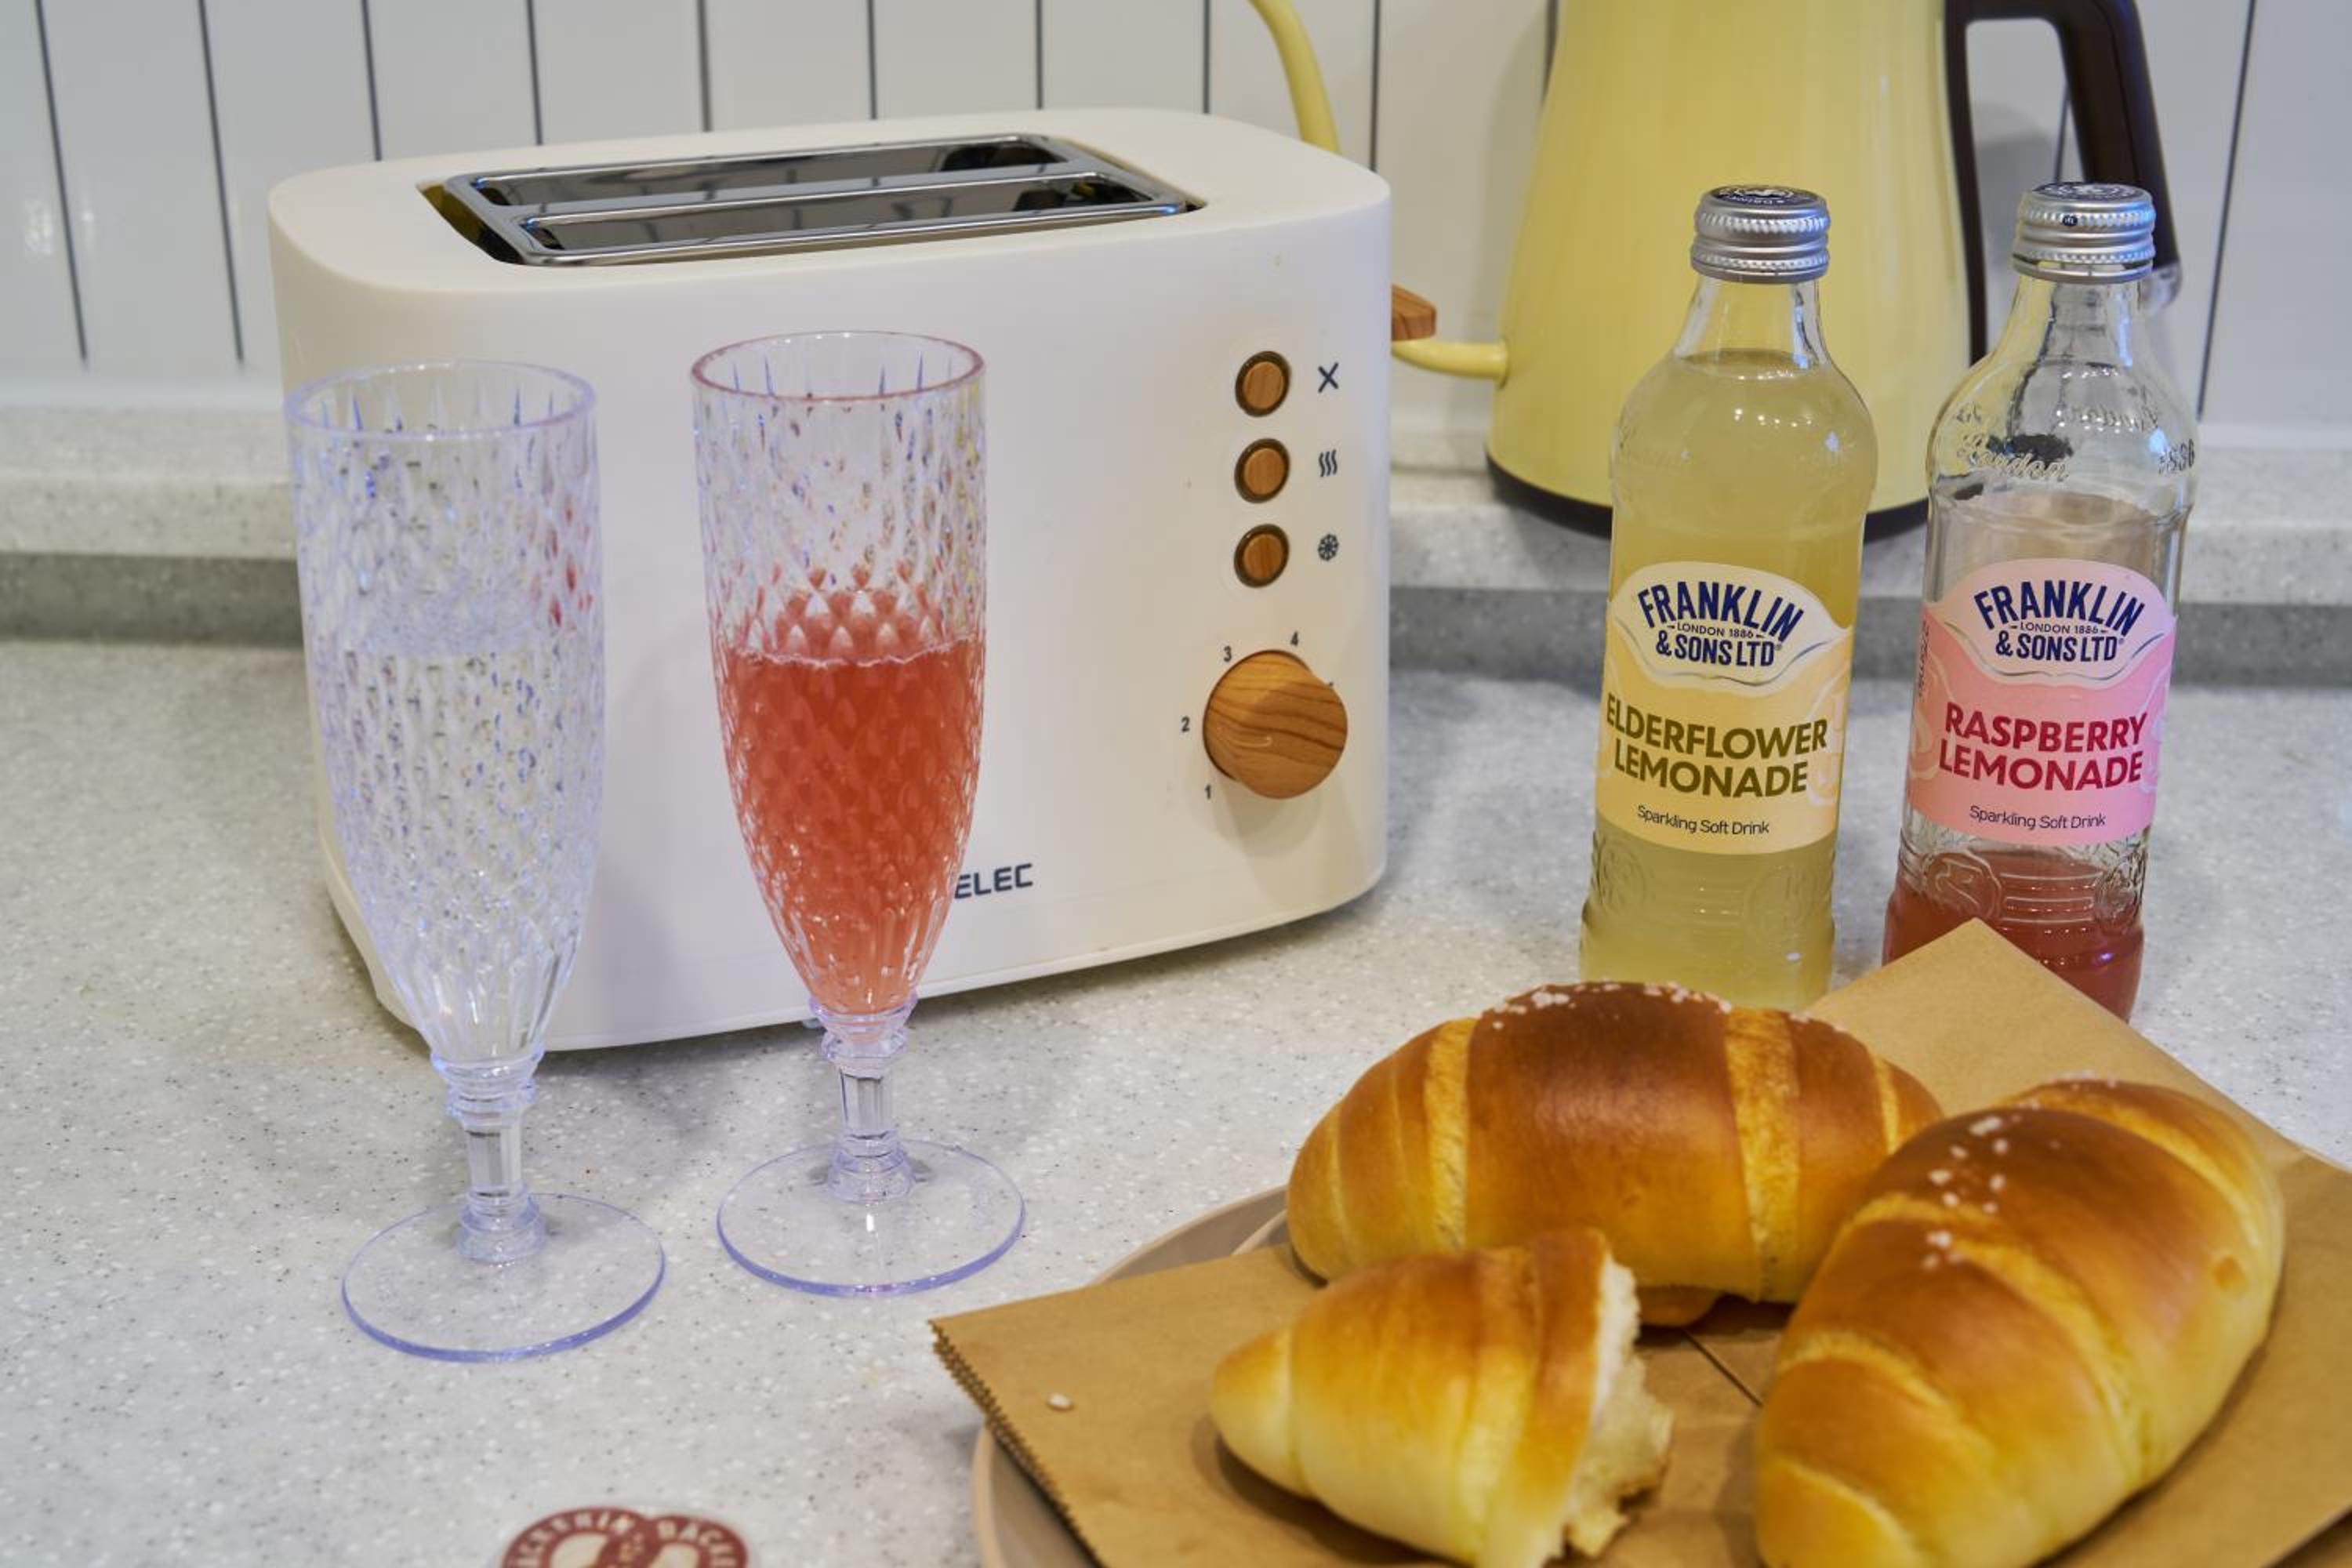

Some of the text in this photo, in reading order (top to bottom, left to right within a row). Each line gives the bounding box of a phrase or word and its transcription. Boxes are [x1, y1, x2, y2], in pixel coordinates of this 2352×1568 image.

[1638, 581, 1804, 642] FRANKLIN
[1973, 580, 2146, 637] FRANKLIN
[1290, 631, 1298, 646] 4
[1677, 622, 1754, 638] LONDON 1886
[2020, 622, 2071, 634] LONDON
[1223, 646, 1232, 662] 3
[1656, 630, 1672, 656] &
[1675, 633, 1733, 666] SONS
[1995, 630, 2013, 657] &
[2016, 633, 2076, 662] SONS
[1181, 717, 1190, 732] 2
[1606, 693, 1827, 760] ELDERFLOWER
[1944, 702, 2147, 753] RASPBERRY
[1614, 739, 1807, 798] LEMONADE
[1938, 739, 2143, 791] LEMONADE
[1205, 785, 1211, 799] 1
[1637, 805, 1769, 835] Sparkling Soft Drink
[1969, 805, 2107, 831] Sparkling Soft Drink
